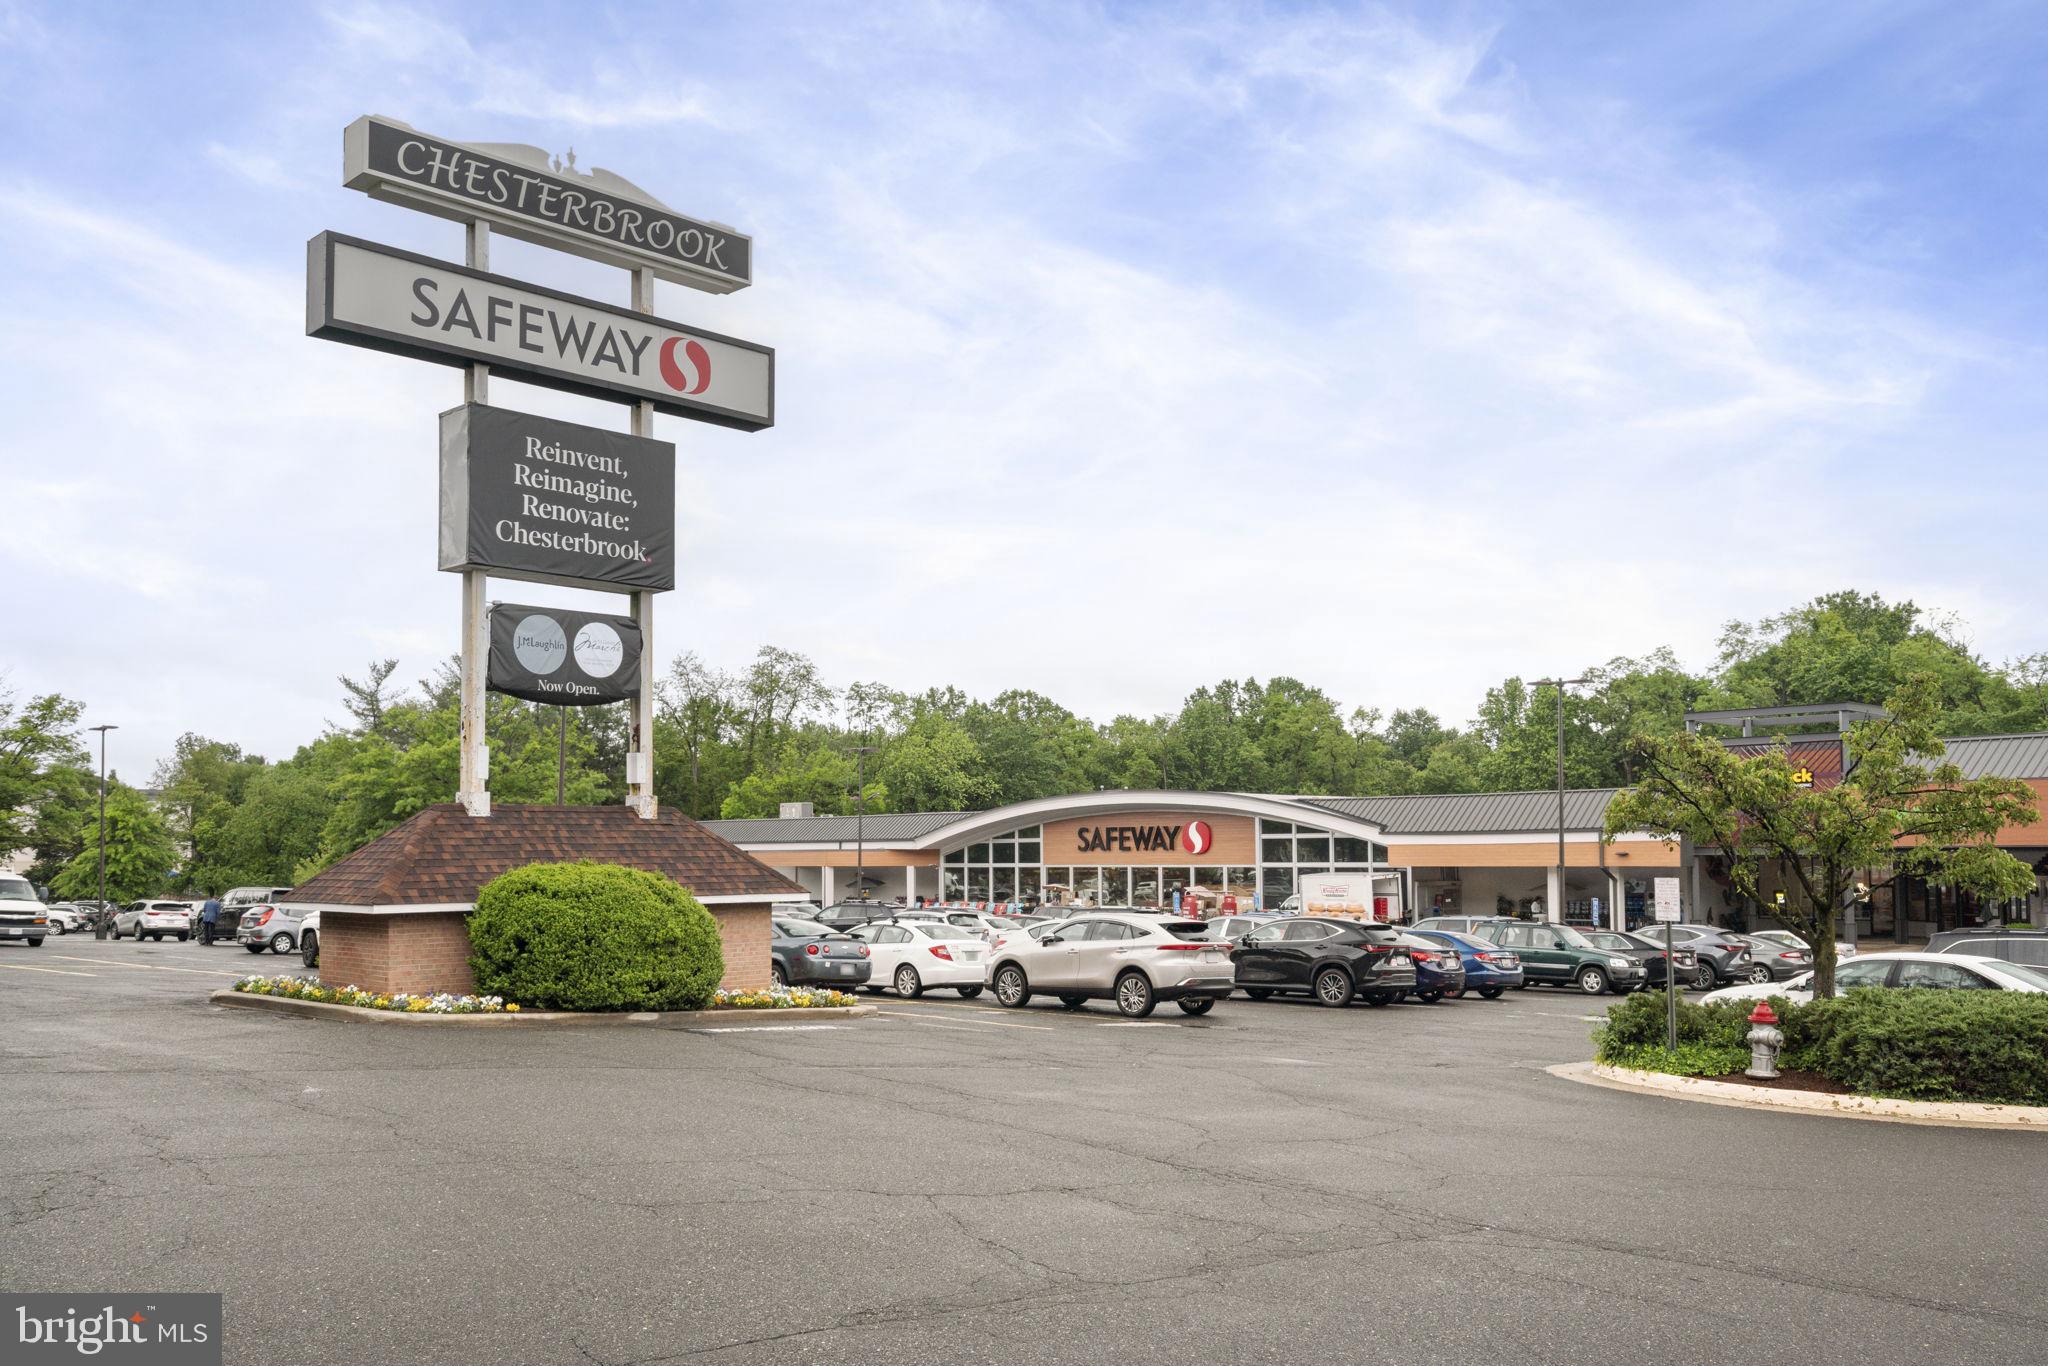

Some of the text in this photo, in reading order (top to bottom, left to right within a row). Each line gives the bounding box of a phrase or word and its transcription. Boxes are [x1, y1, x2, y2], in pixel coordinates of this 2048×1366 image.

[396, 140, 730, 271] CHESTERBROOK
[410, 277, 653, 377] SAFEWAY
[525, 436, 628, 480] Reinvent,
[514, 463, 639, 509] Reimagine,
[522, 494, 630, 532] Renovate:
[495, 519, 653, 565] Chesterbrook.
[537, 679, 600, 697] Now Open.
[1077, 825, 1181, 852] SAFEWAY
